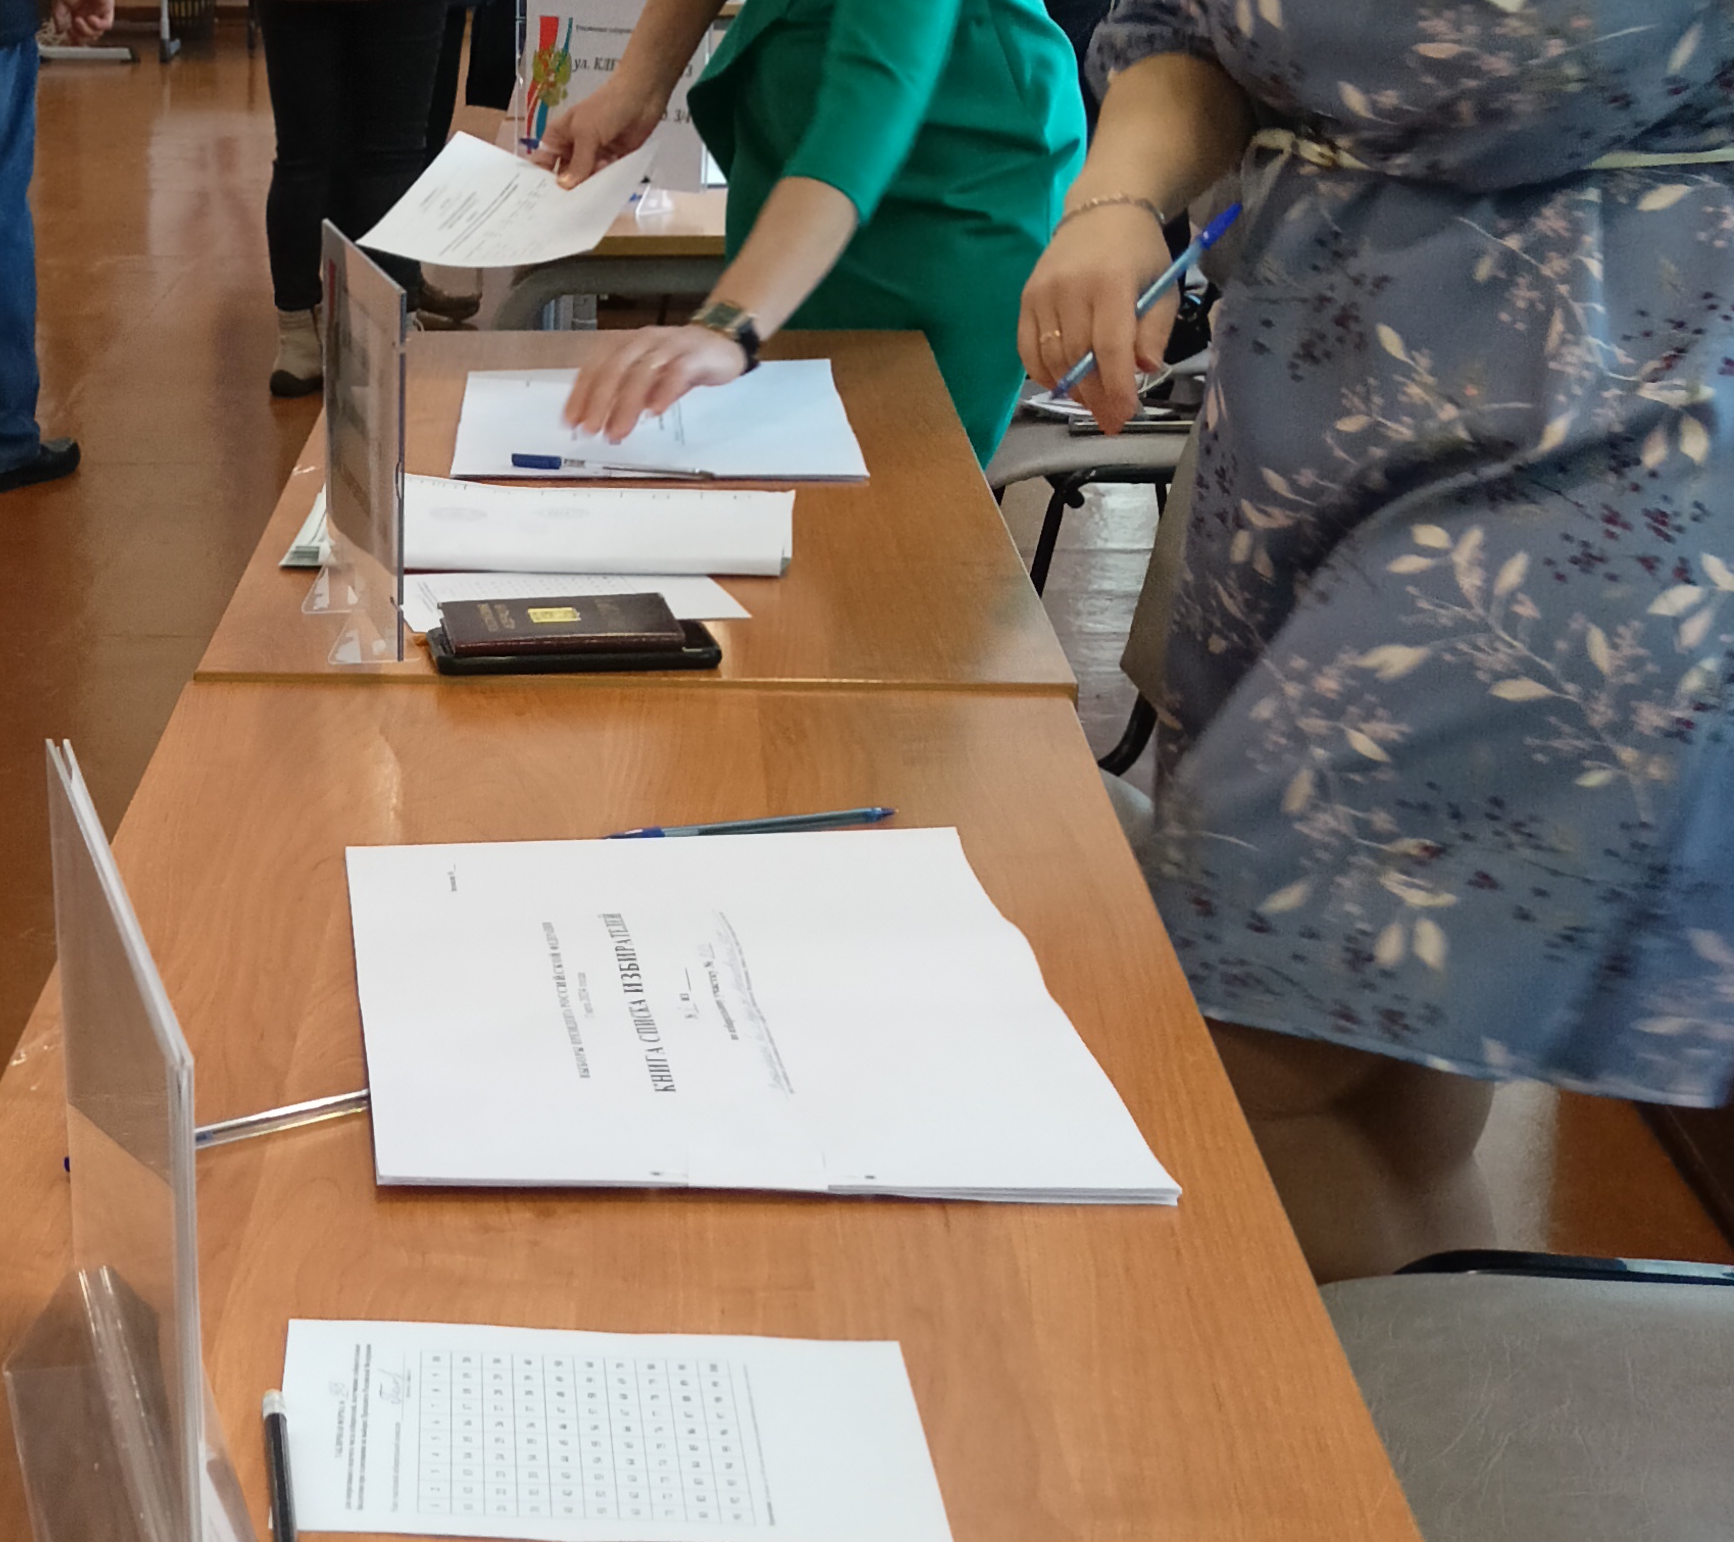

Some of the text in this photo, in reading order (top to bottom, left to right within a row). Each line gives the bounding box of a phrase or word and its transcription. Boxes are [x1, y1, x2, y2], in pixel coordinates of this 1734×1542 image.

[549, 952, 570, 1008] РОССИЙСКОЙ
[597, 913, 676, 1092] КНИГА СПИСКА ИЗБИРАТЕЛЕЙ
[572, 1046, 590, 1079] ВЫБОРЫ
